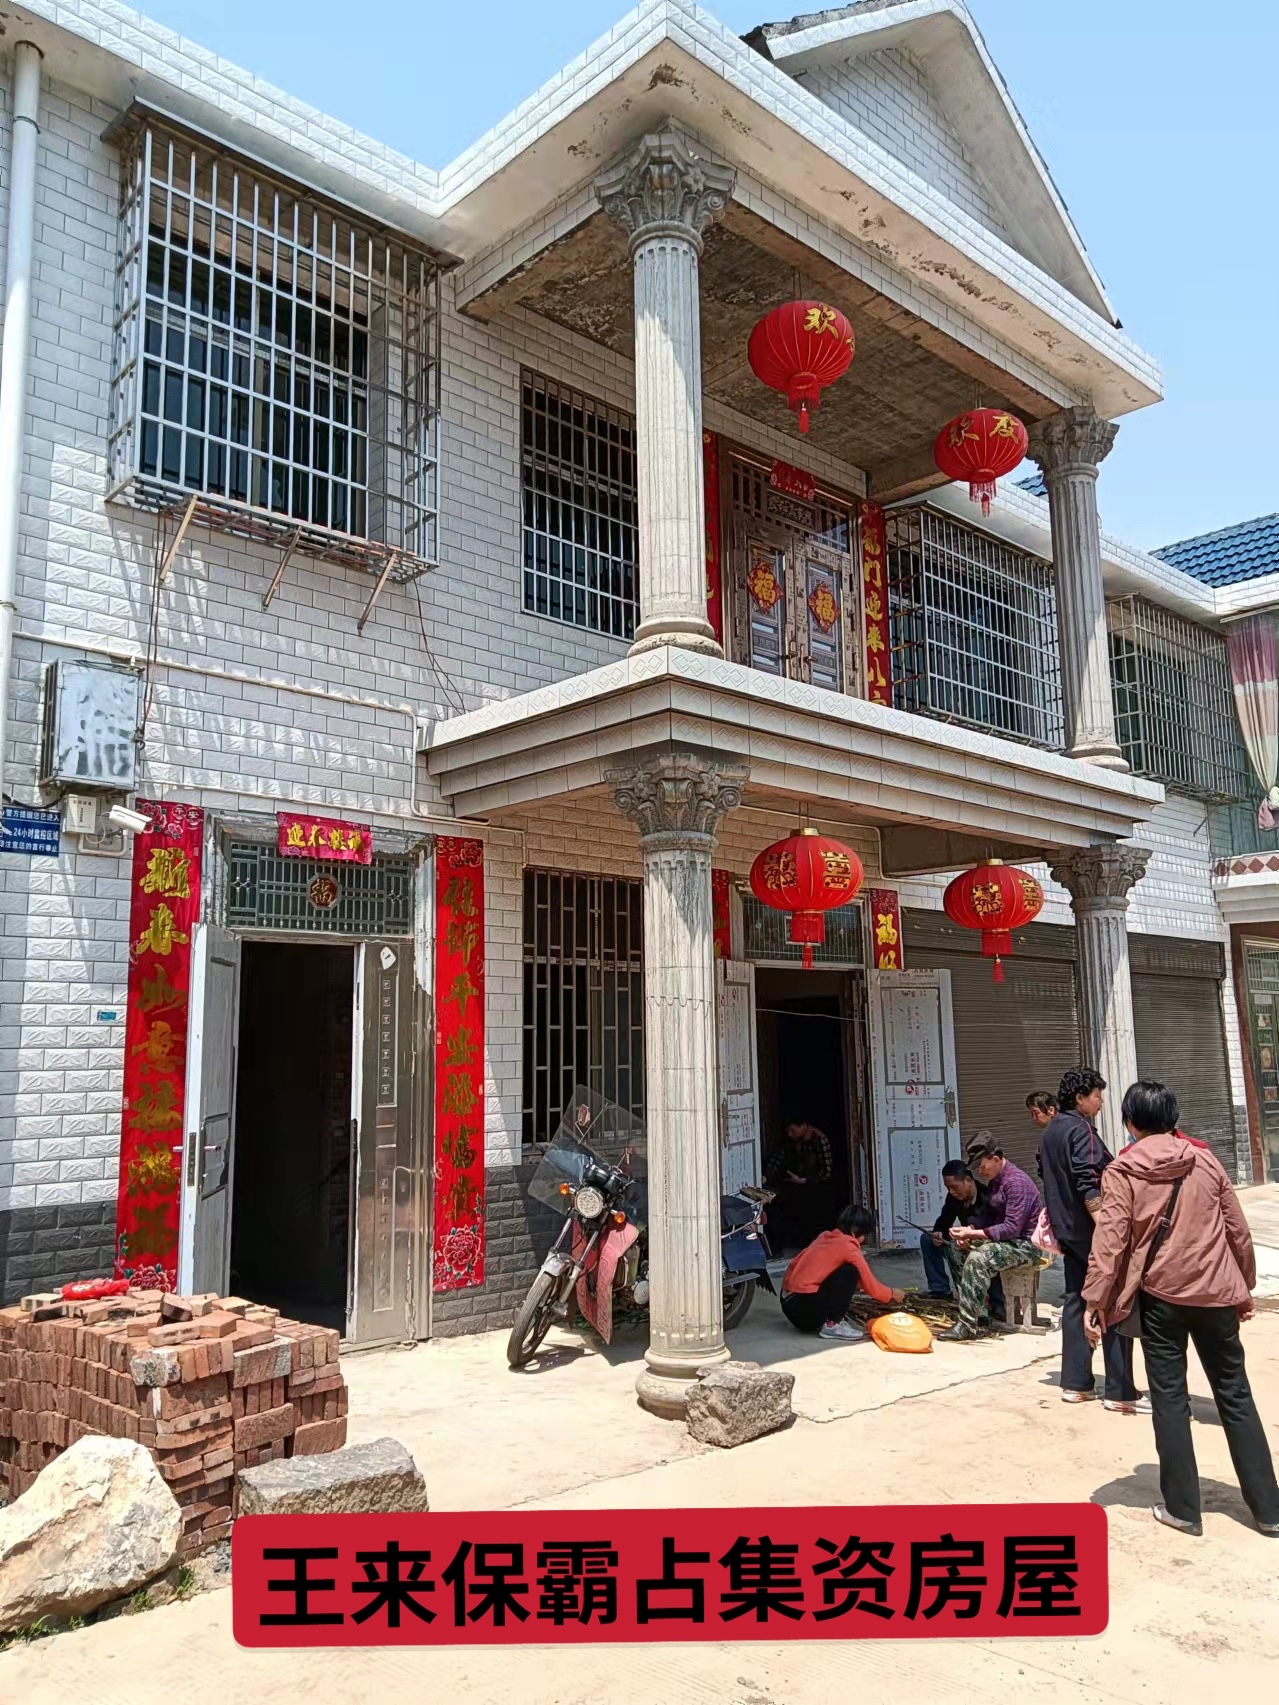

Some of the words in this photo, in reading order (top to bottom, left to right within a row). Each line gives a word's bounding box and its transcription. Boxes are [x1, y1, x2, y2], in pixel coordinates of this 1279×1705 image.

[754, 570, 776, 603] 福
[816, 590, 835, 623] 福
[13, 828, 59, 841] 24小时监控区域
[311, 879, 332, 904] 福
